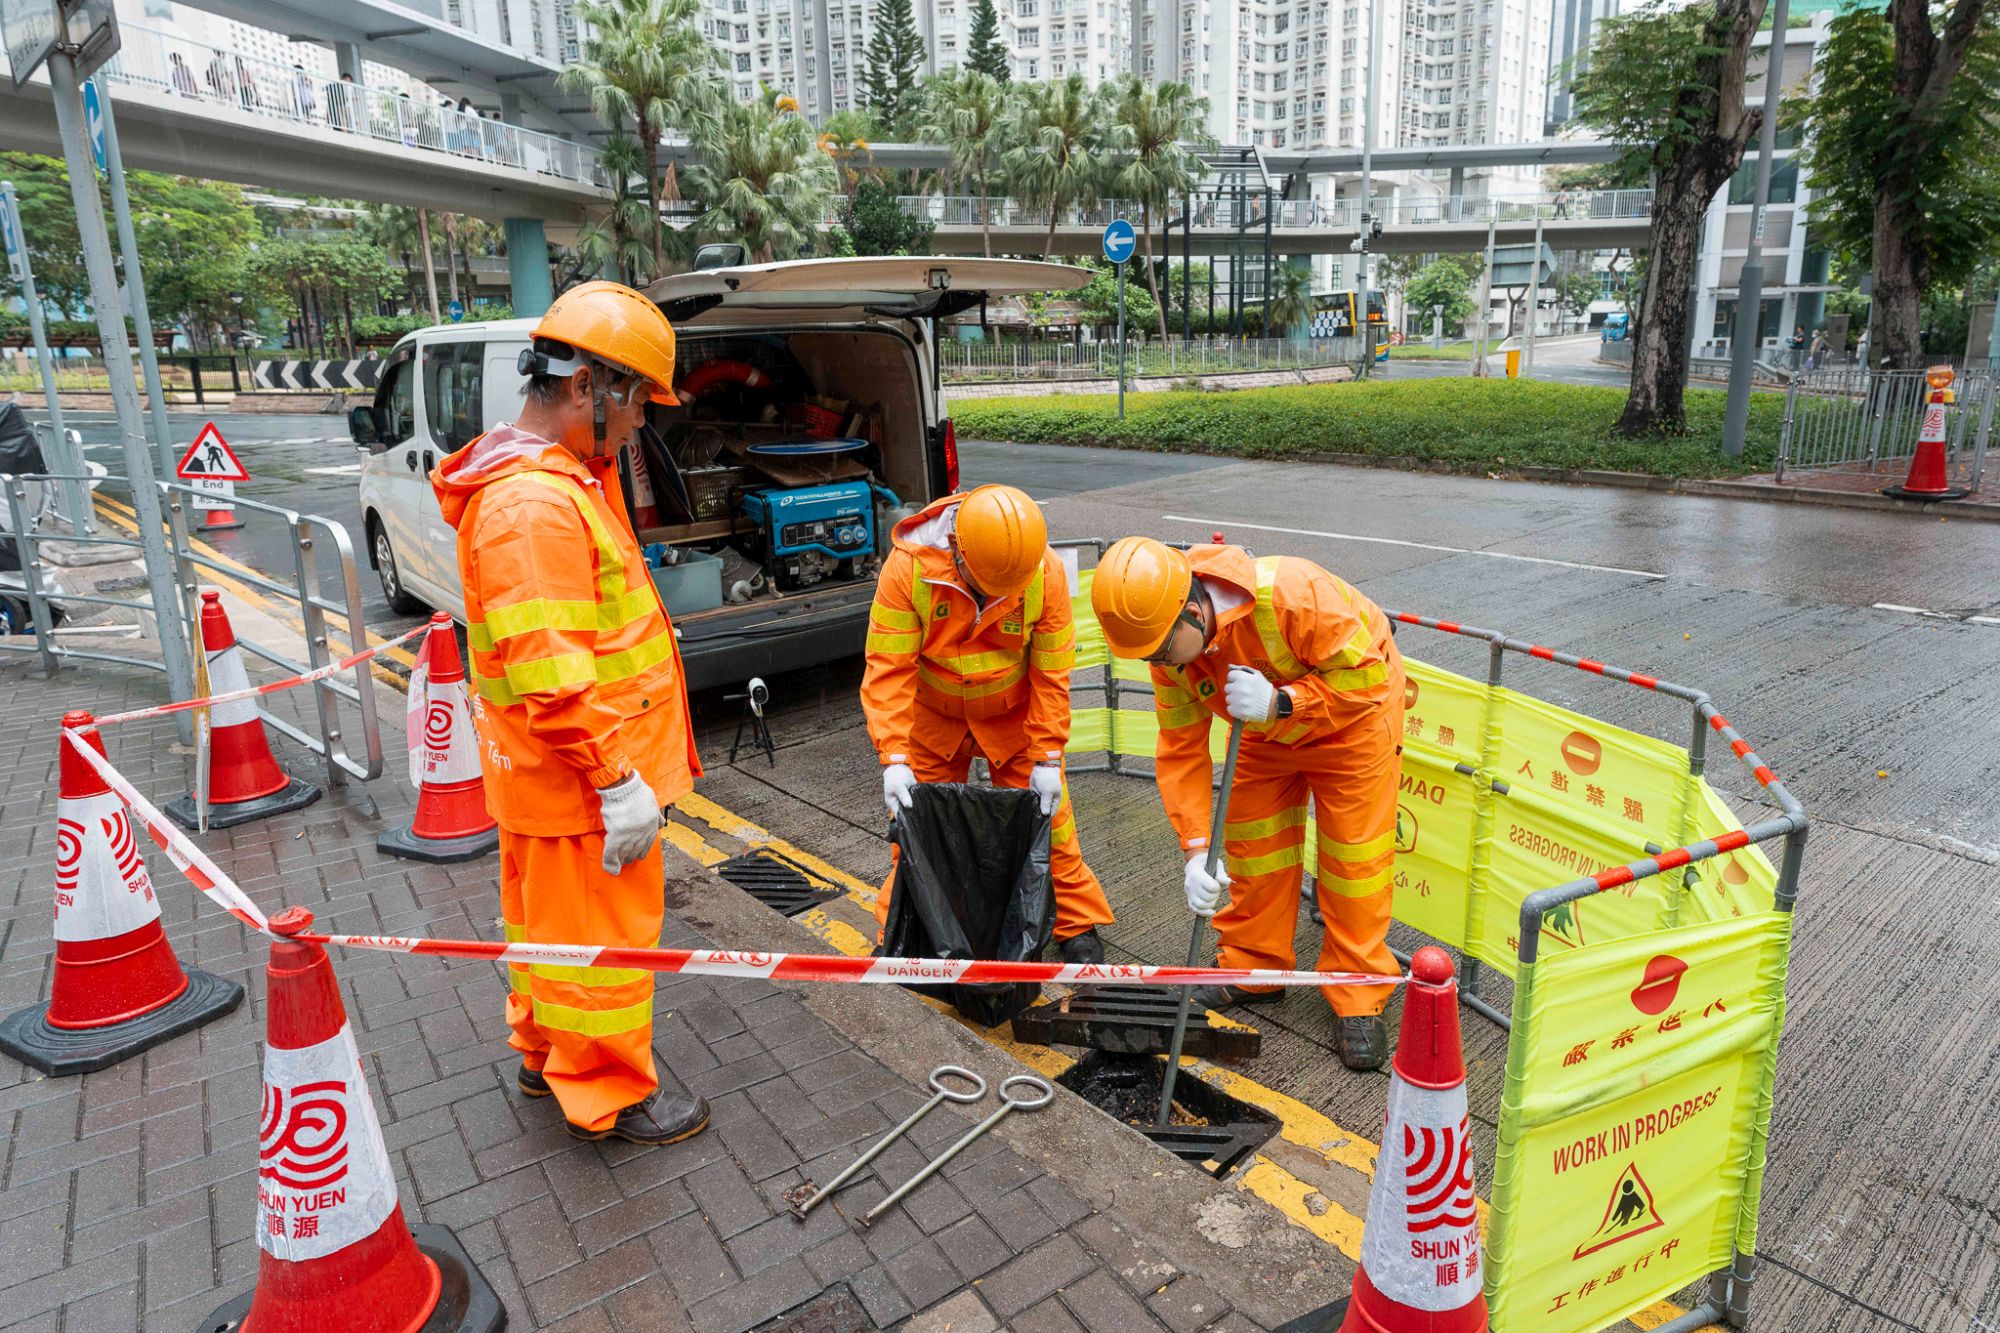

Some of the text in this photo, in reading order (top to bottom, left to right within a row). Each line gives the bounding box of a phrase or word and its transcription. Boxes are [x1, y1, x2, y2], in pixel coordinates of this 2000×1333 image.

[202, 480, 224, 489] End
[887, 966, 953, 978] DANGER
[1553, 1086, 1722, 1175] WORK IN PROGRESS
[291, 1186, 346, 1213] YUEN
[268, 1214, 319, 1239] 順源
[1411, 1238, 1460, 1260] SHUN
[1436, 1250, 1478, 1286] 順源
[1547, 1238, 1680, 1314] 工作進行中
